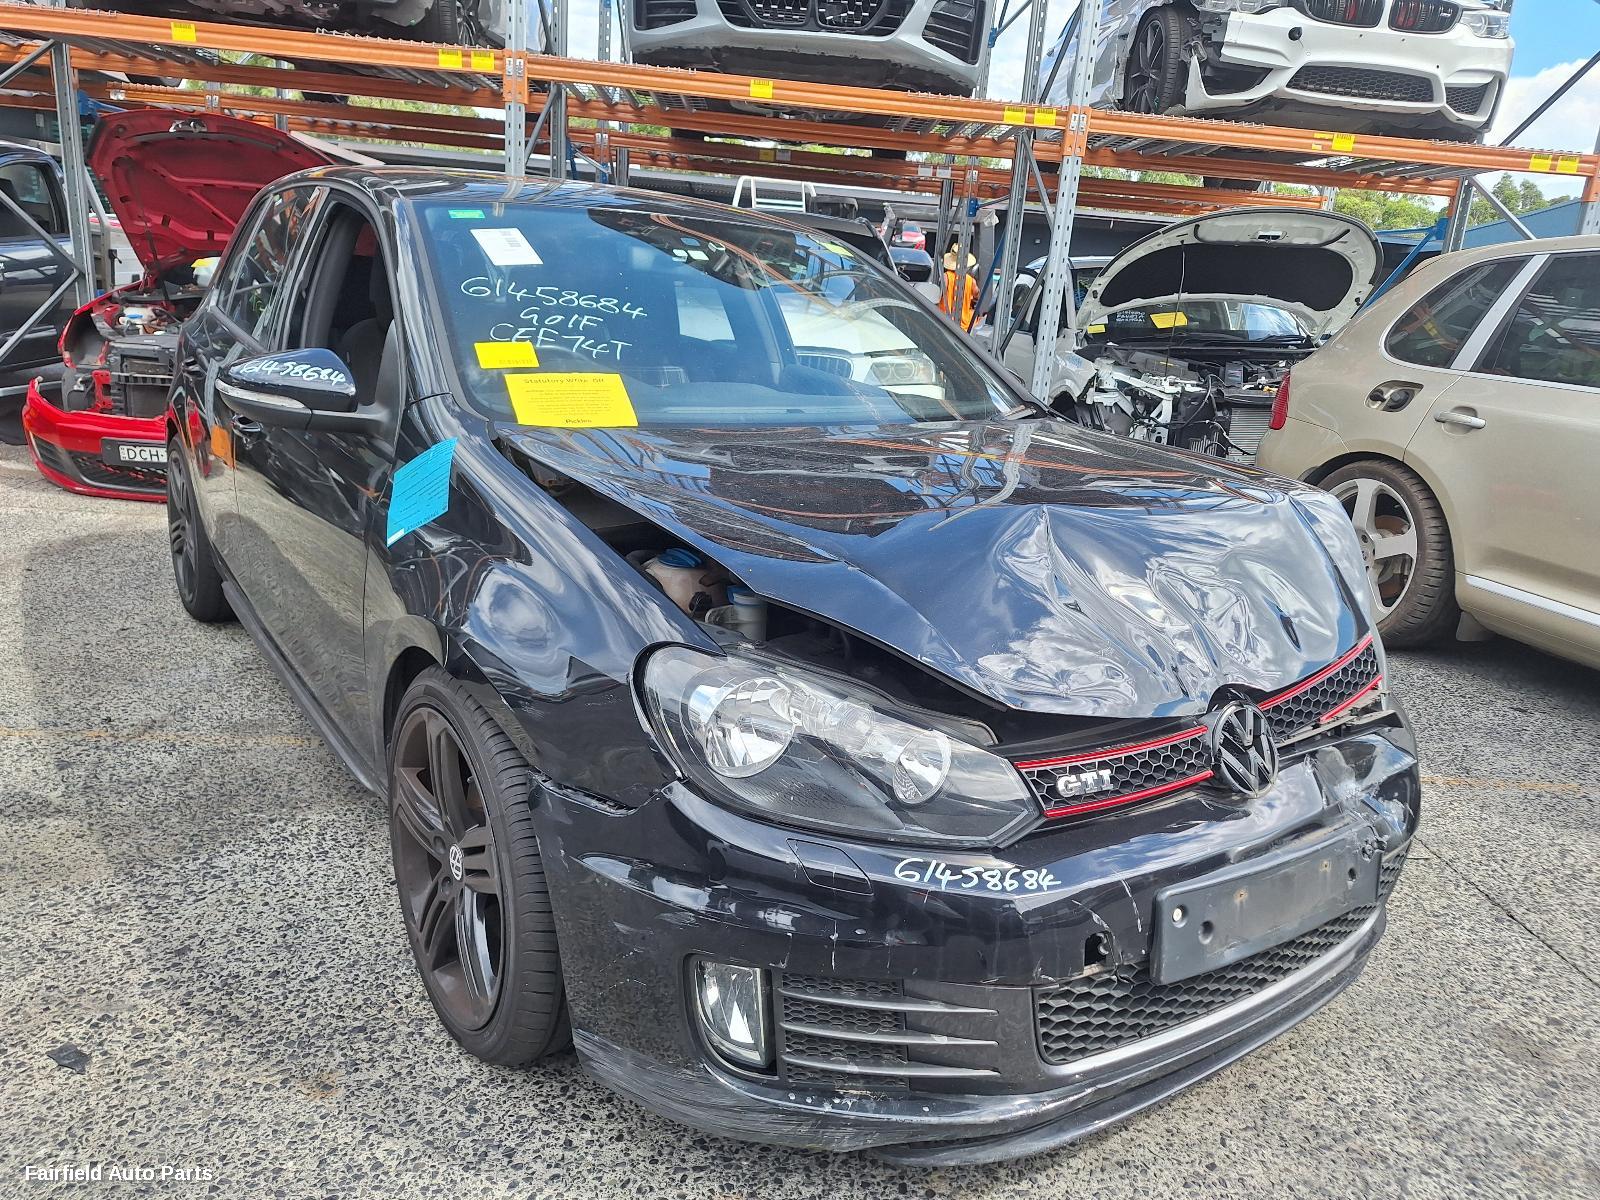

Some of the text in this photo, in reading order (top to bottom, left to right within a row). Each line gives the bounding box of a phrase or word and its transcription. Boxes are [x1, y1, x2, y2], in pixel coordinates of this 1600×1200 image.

[460, 277, 648, 319] 61458684
[239, 359, 346, 386] 61458684
[1056, 769, 1114, 798] GTI
[894, 857, 1062, 892] 61458684
